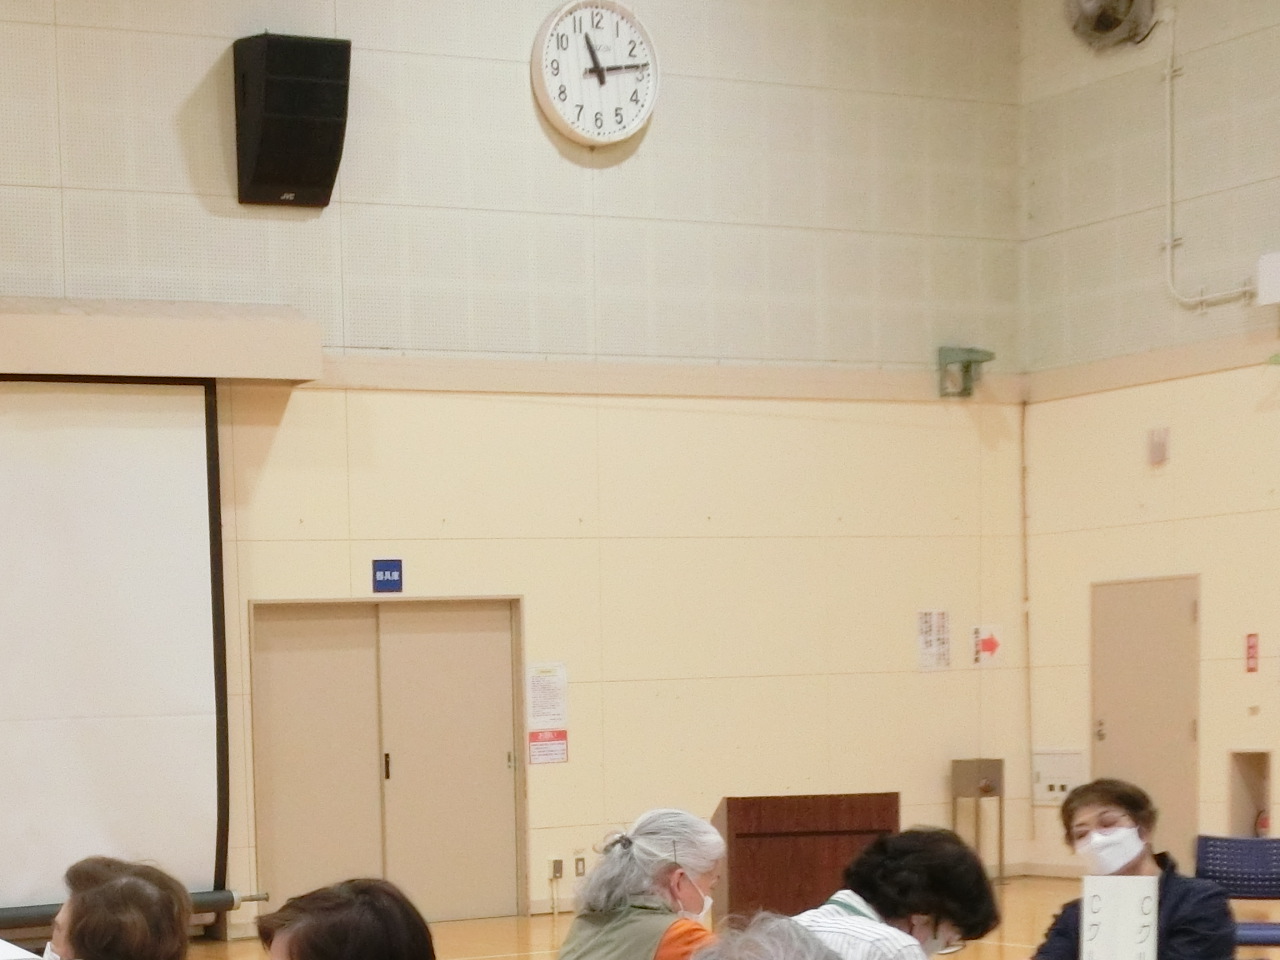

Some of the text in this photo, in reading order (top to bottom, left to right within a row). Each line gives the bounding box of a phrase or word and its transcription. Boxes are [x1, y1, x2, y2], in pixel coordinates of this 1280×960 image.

[573, 15, 583, 34] 11
[591, 11, 604, 30] 12
[556, 33, 569, 50] 10
[628, 40, 637, 58] 2
[551, 59, 560, 77] 9
[558, 84, 568, 102] 8
[630, 88, 640, 105] 4
[575, 104, 585, 122] 7
[594, 111, 604, 130] 6
[614, 107, 624, 125] 5
[280, 192, 295, 200] JVC
